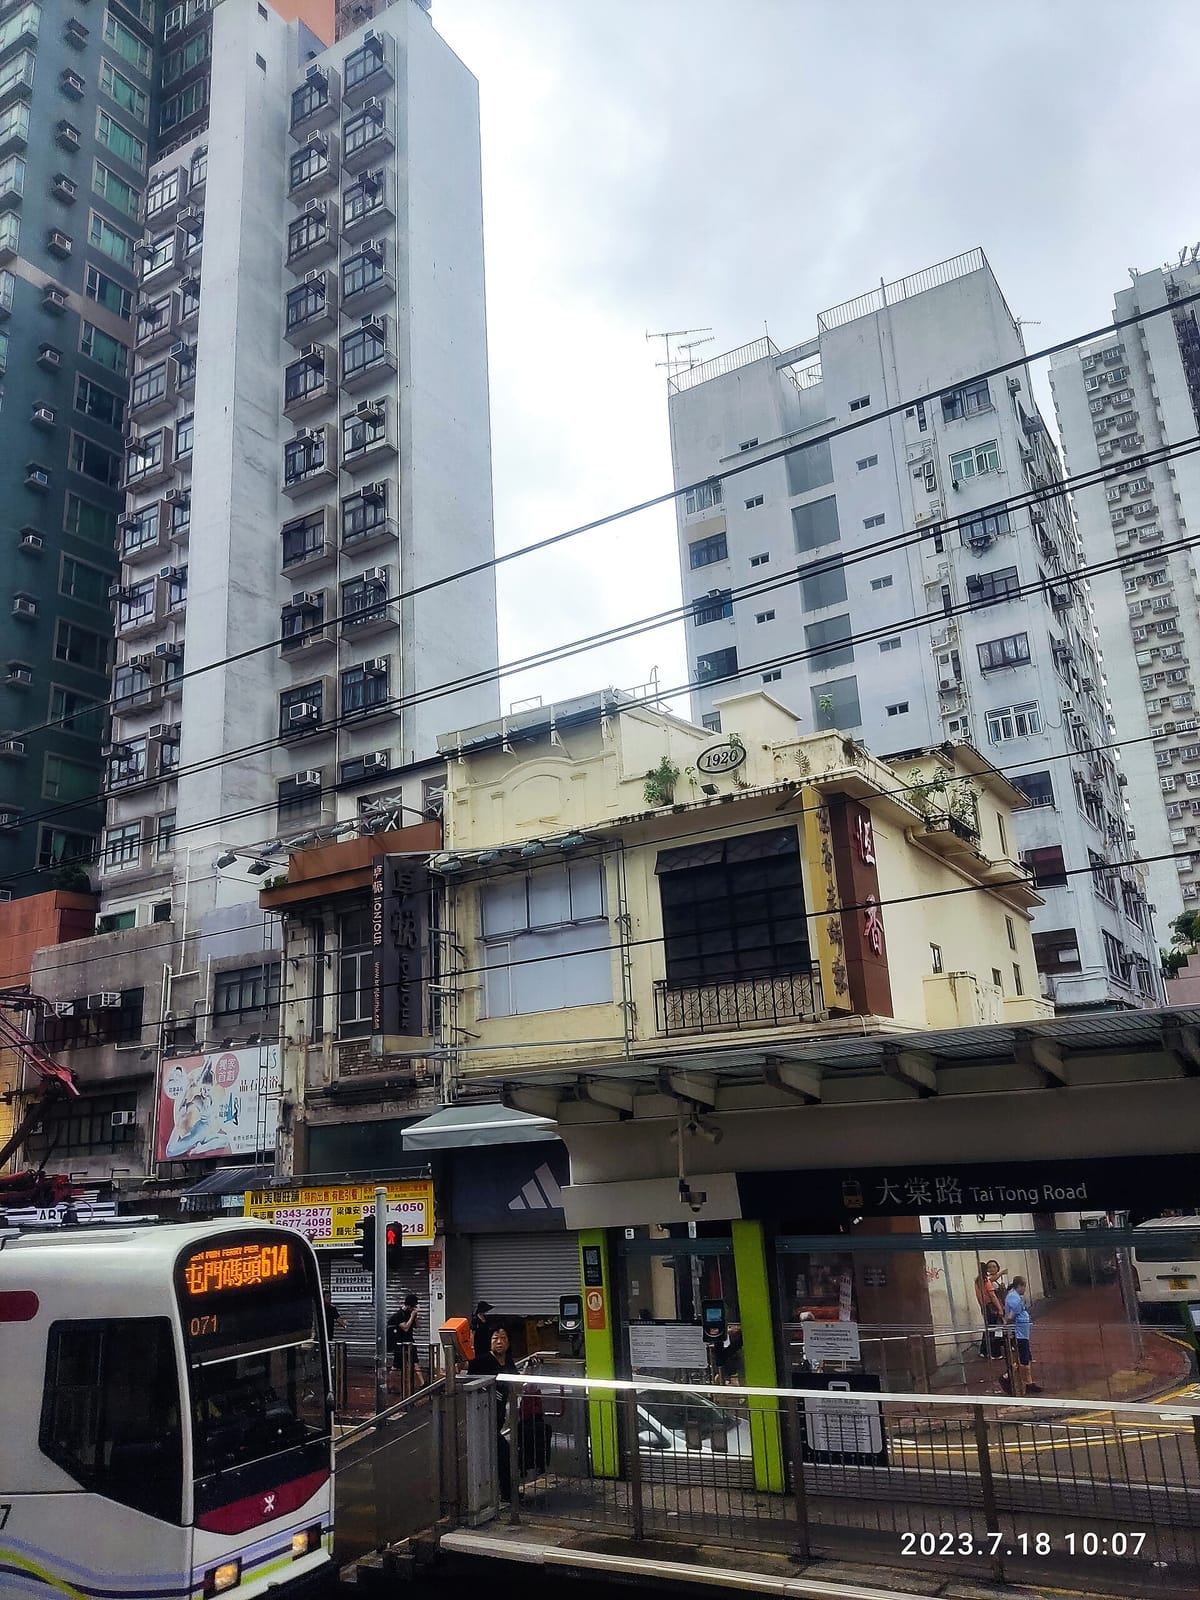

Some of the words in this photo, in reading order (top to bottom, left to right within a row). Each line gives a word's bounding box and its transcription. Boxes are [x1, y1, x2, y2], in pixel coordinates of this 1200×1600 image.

[706, 750, 738, 767] 1920
[875, 1175, 963, 1206] 大棠路
[969, 1185, 993, 1202] Tai
[998, 1185, 1039, 1205] Tong
[1043, 1183, 1088, 1200] Road
[276, 1208, 332, 1219] 9343-2877
[363, 1203, 424, 1214] 981-4050
[184, 1254, 262, 1294] 屯門碼頭
[261, 1244, 289, 1277] 614
[190, 1314, 217, 1336] 071
